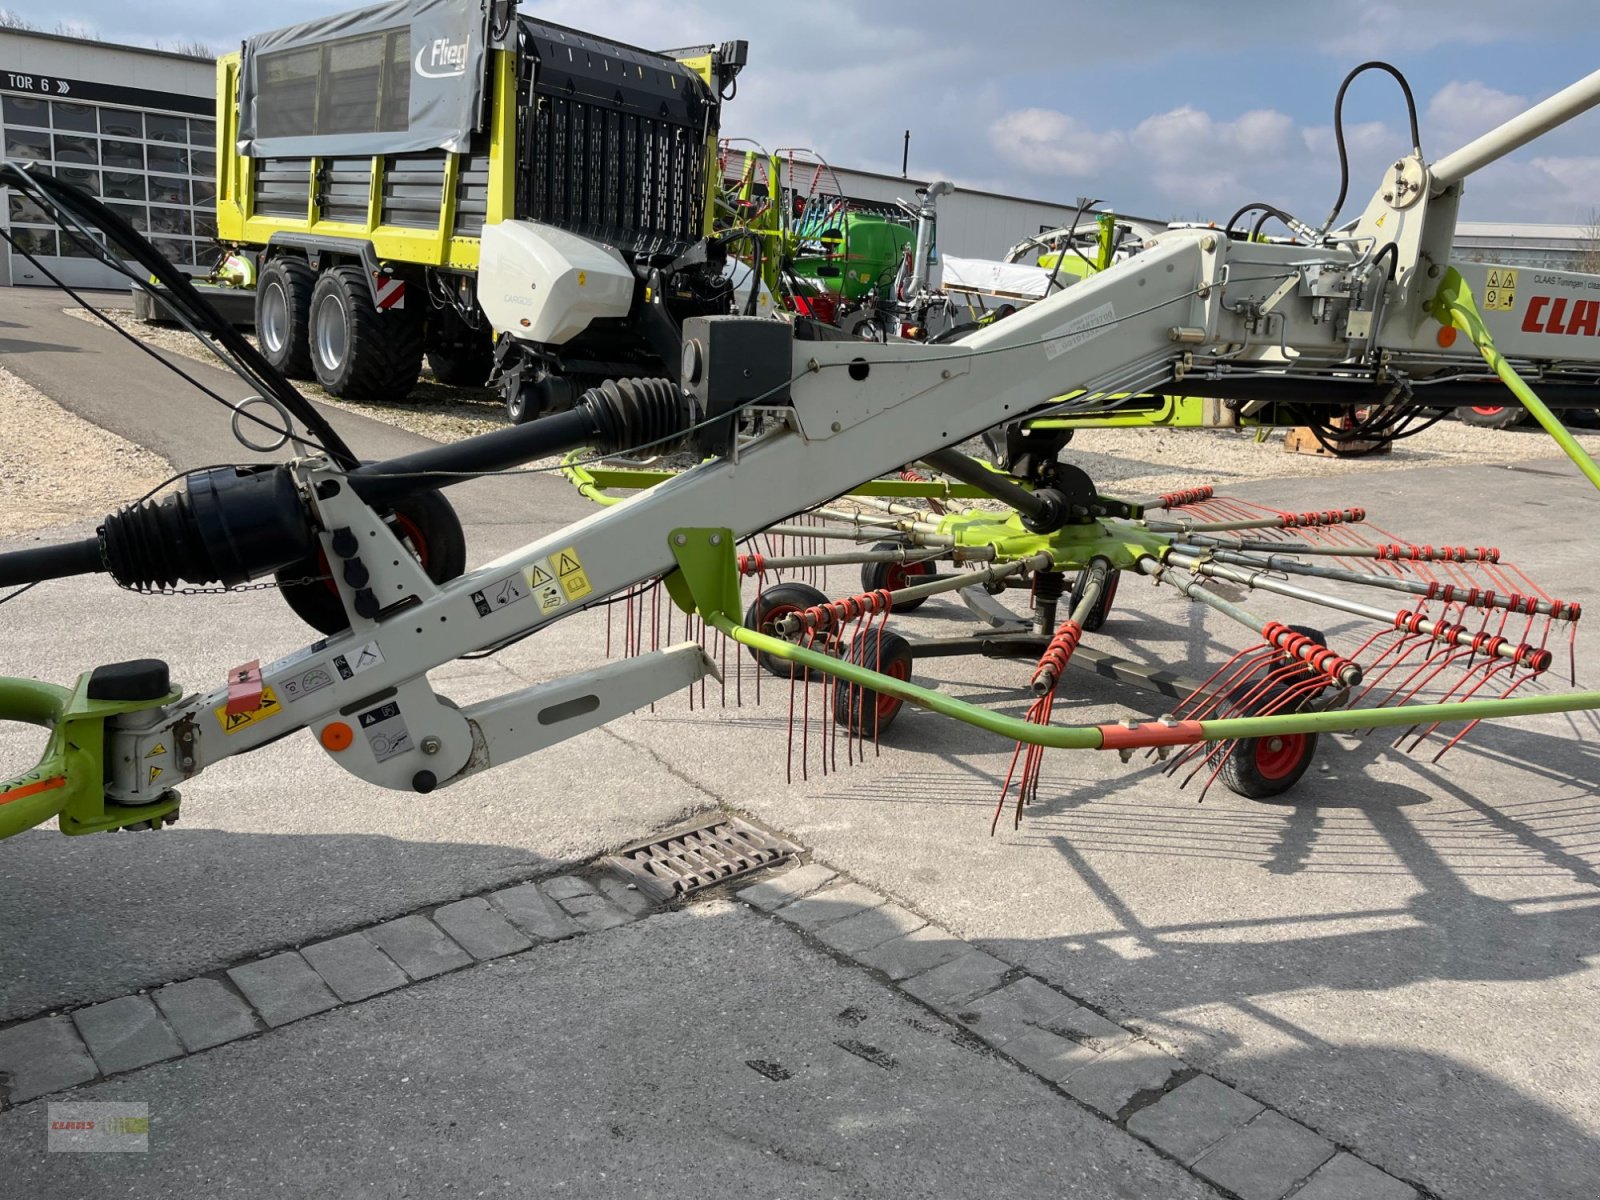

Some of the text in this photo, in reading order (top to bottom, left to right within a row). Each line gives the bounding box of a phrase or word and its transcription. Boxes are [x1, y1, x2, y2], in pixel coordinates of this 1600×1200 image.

[430, 33, 470, 71] Fliegl
[8, 74, 49, 92] TOR 6
[1534, 274, 1556, 285] CLAAS
[1521, 296, 1600, 337] CLA
